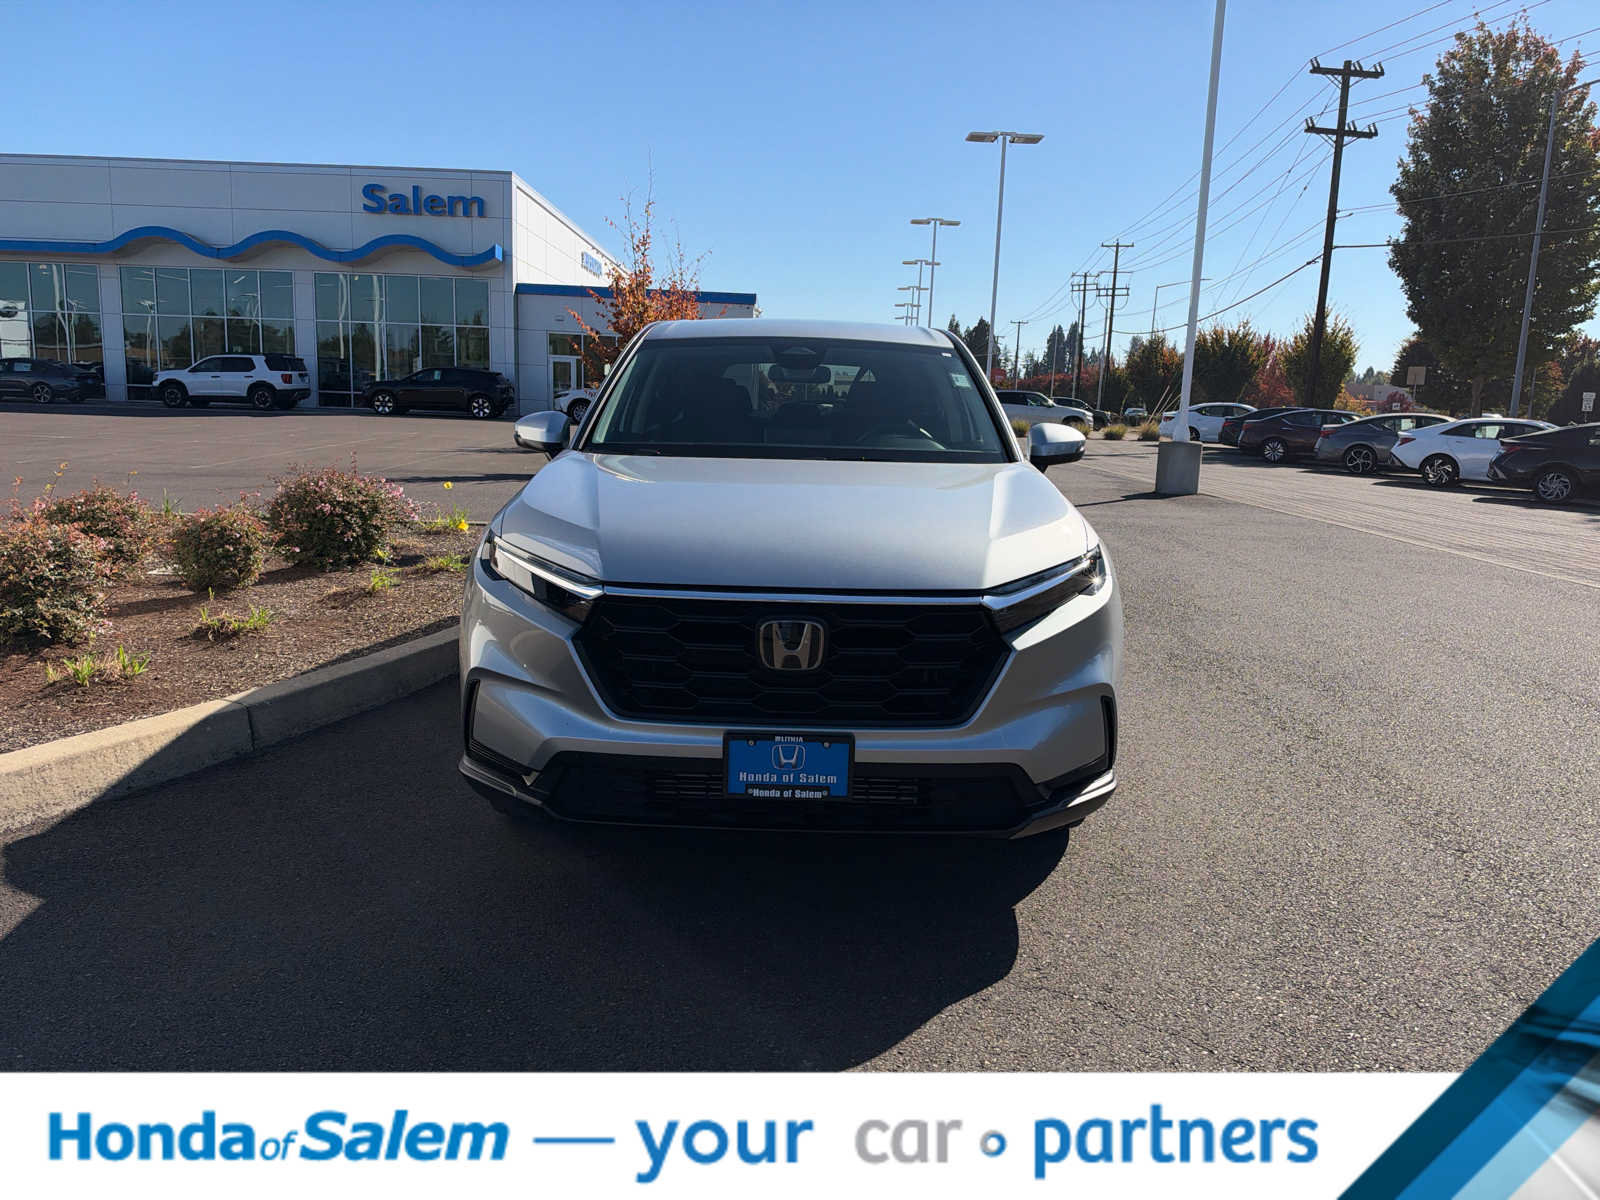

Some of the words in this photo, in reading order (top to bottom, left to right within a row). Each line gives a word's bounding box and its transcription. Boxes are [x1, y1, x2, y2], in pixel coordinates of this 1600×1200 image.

[361, 183, 486, 218] Salem
[739, 771, 777, 783] Honda
[782, 773, 794, 783] of
[799, 773, 837, 784] Salem
[752, 788, 780, 798] Honda
[783, 789, 793, 798] of
[794, 789, 822, 799] Salem
